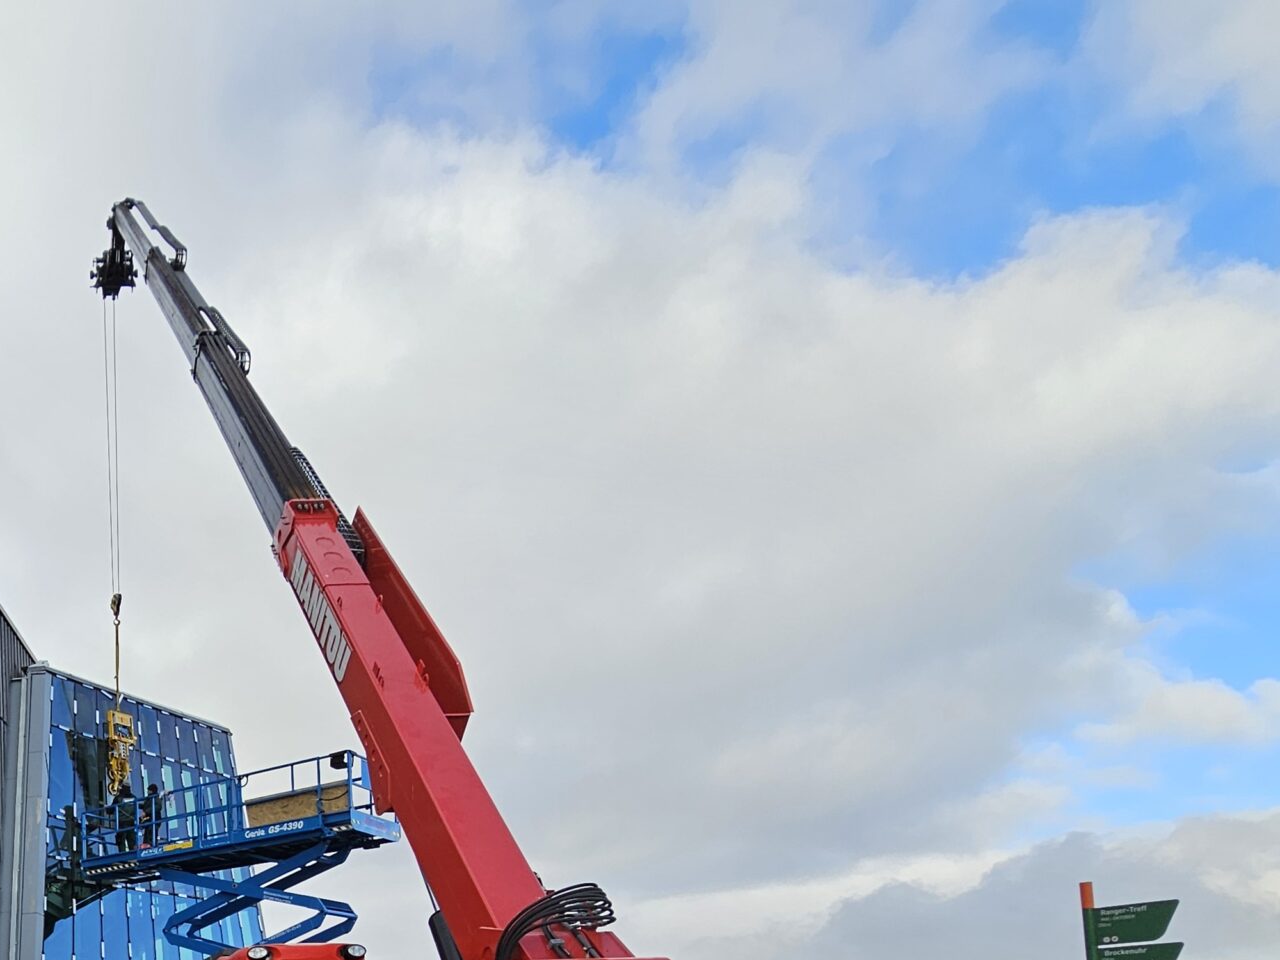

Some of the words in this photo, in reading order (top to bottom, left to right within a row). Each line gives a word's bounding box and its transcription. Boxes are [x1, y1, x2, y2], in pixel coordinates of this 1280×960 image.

[290, 549, 352, 682] MANITOU
[245, 829, 265, 839] Genie
[268, 821, 304, 834] GS-4390
[1100, 905, 1147, 916] Ranger-Treff
